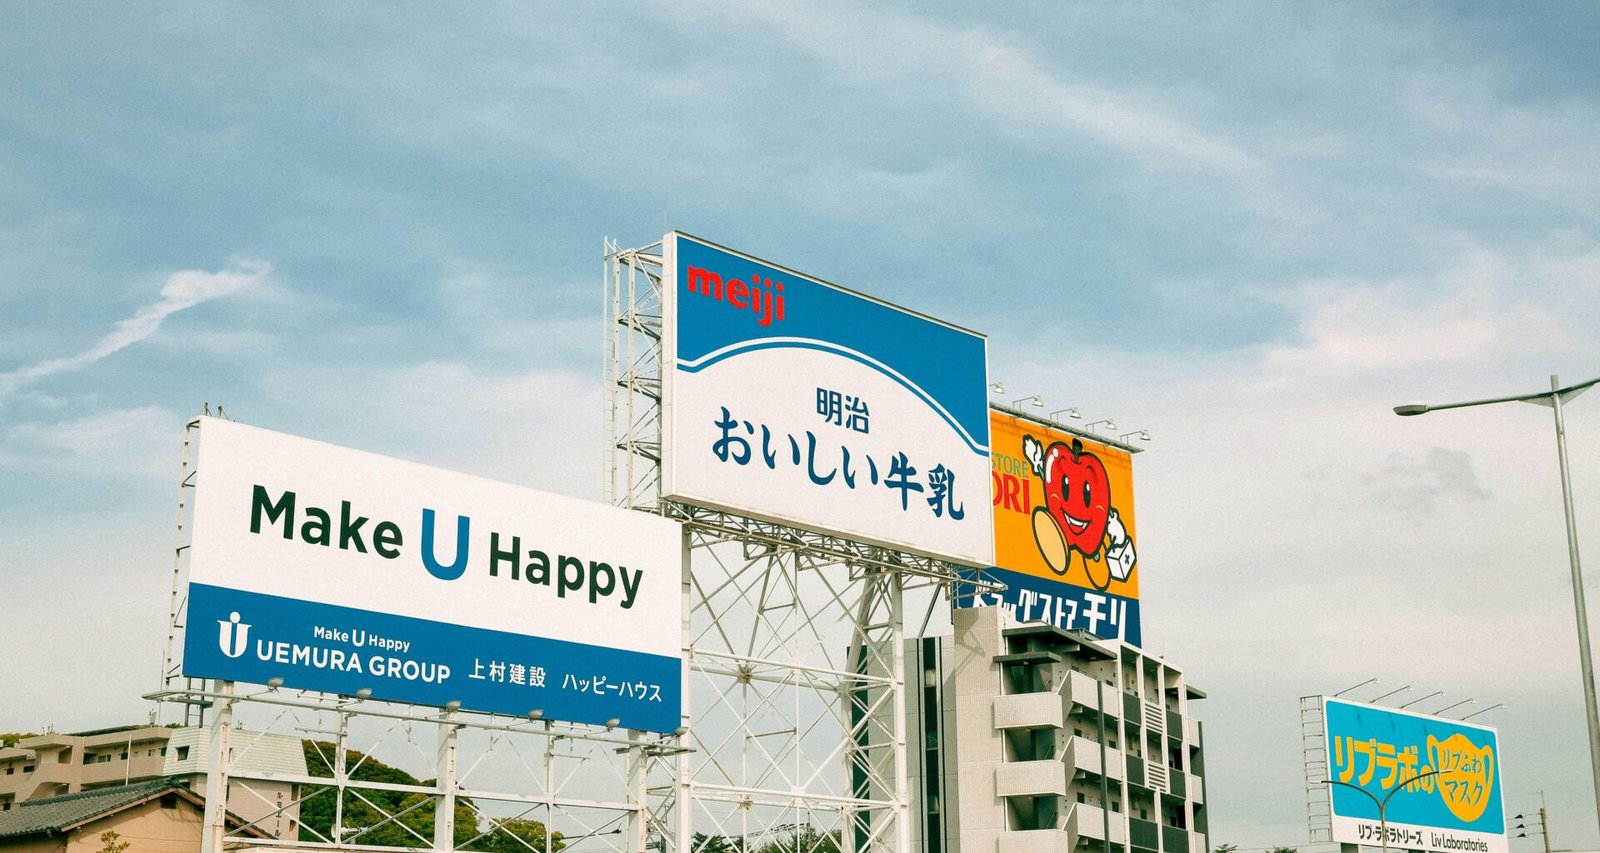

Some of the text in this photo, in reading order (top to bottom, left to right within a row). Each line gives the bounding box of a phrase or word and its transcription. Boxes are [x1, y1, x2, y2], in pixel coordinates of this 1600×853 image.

[688, 264, 785, 327] meiji
[816, 387, 870, 435] 明治
[712, 405, 965, 521] おいしい牛乳
[249, 484, 644, 610] Make U Happy
[256, 639, 451, 685] UEMURA GROUP
[313, 625, 411, 654] Make U Happy
[468, 658, 663, 703] 上村建設 ハッピーハウス
[1444, 780, 1483, 807] マスク
[1442, 833, 1489, 853] Laboratories
